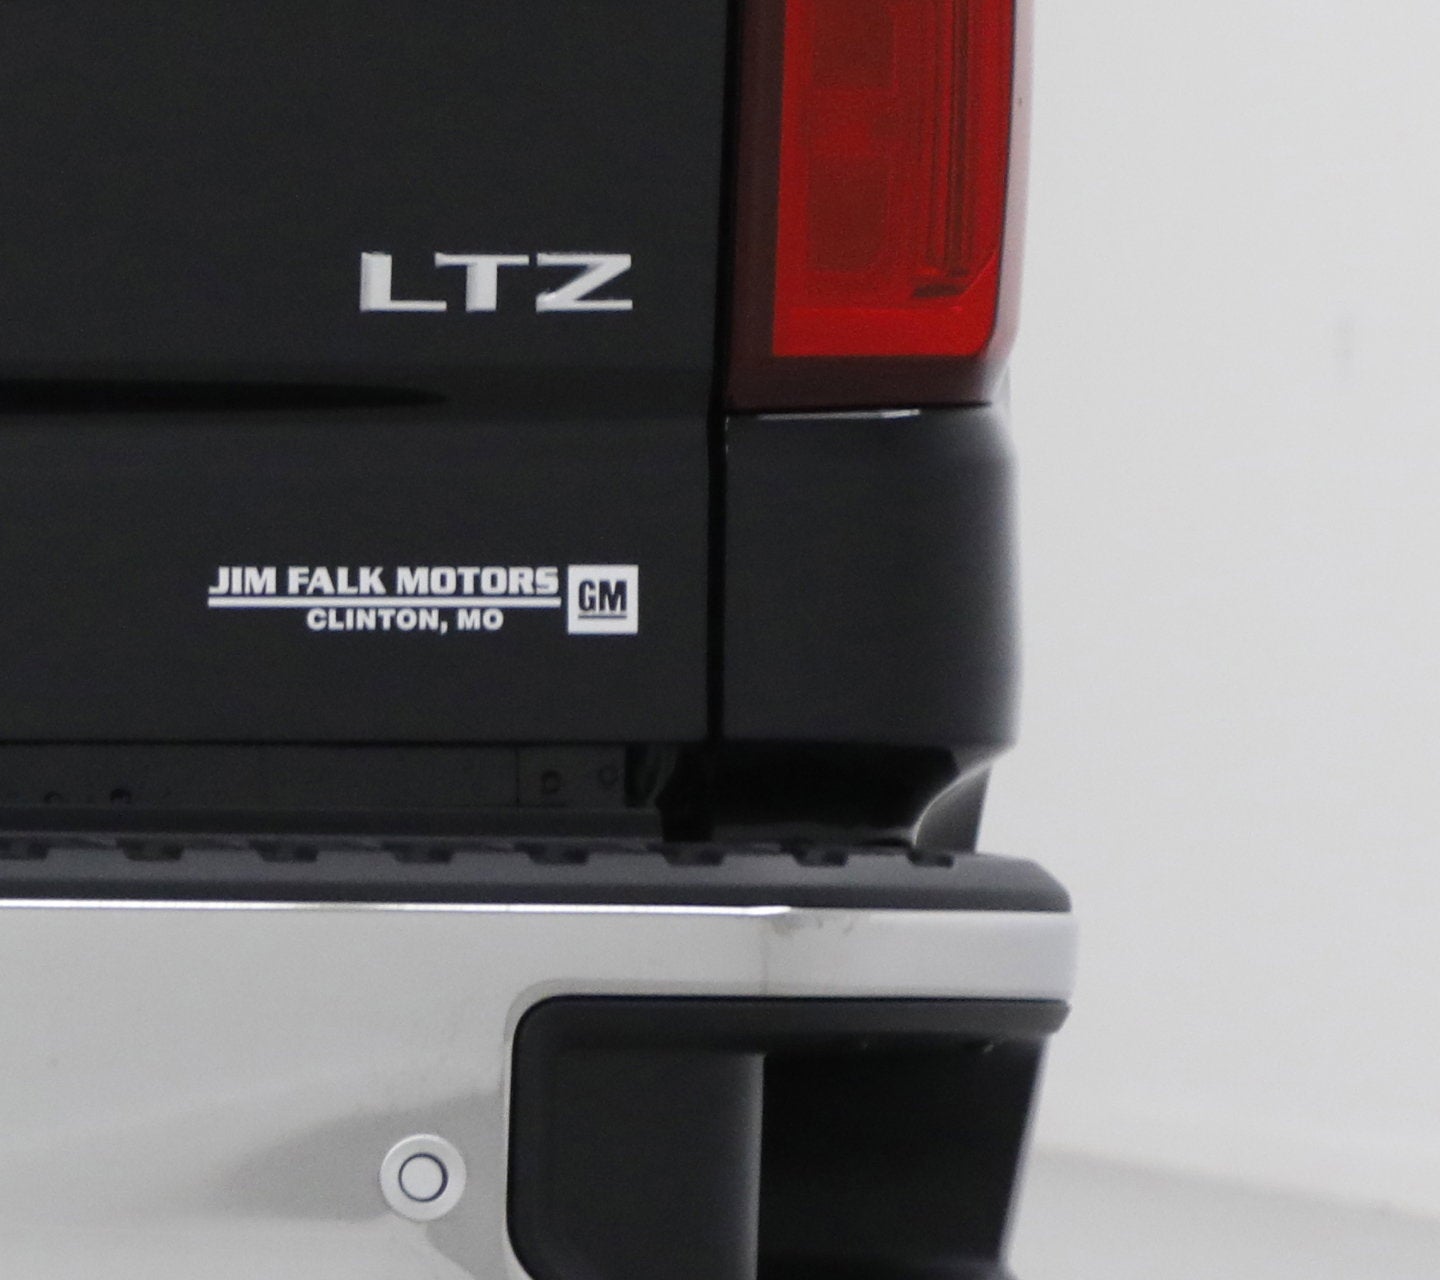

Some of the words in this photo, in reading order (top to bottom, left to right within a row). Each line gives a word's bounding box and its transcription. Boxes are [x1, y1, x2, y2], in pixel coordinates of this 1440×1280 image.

[359, 252, 633, 312] LTZ
[208, 566, 277, 595] JIM
[288, 566, 386, 595] FALK
[396, 566, 560, 595] MOTORS
[578, 580, 628, 613] GM
[306, 609, 449, 635] CLINTON,
[456, 609, 505, 631] MO
